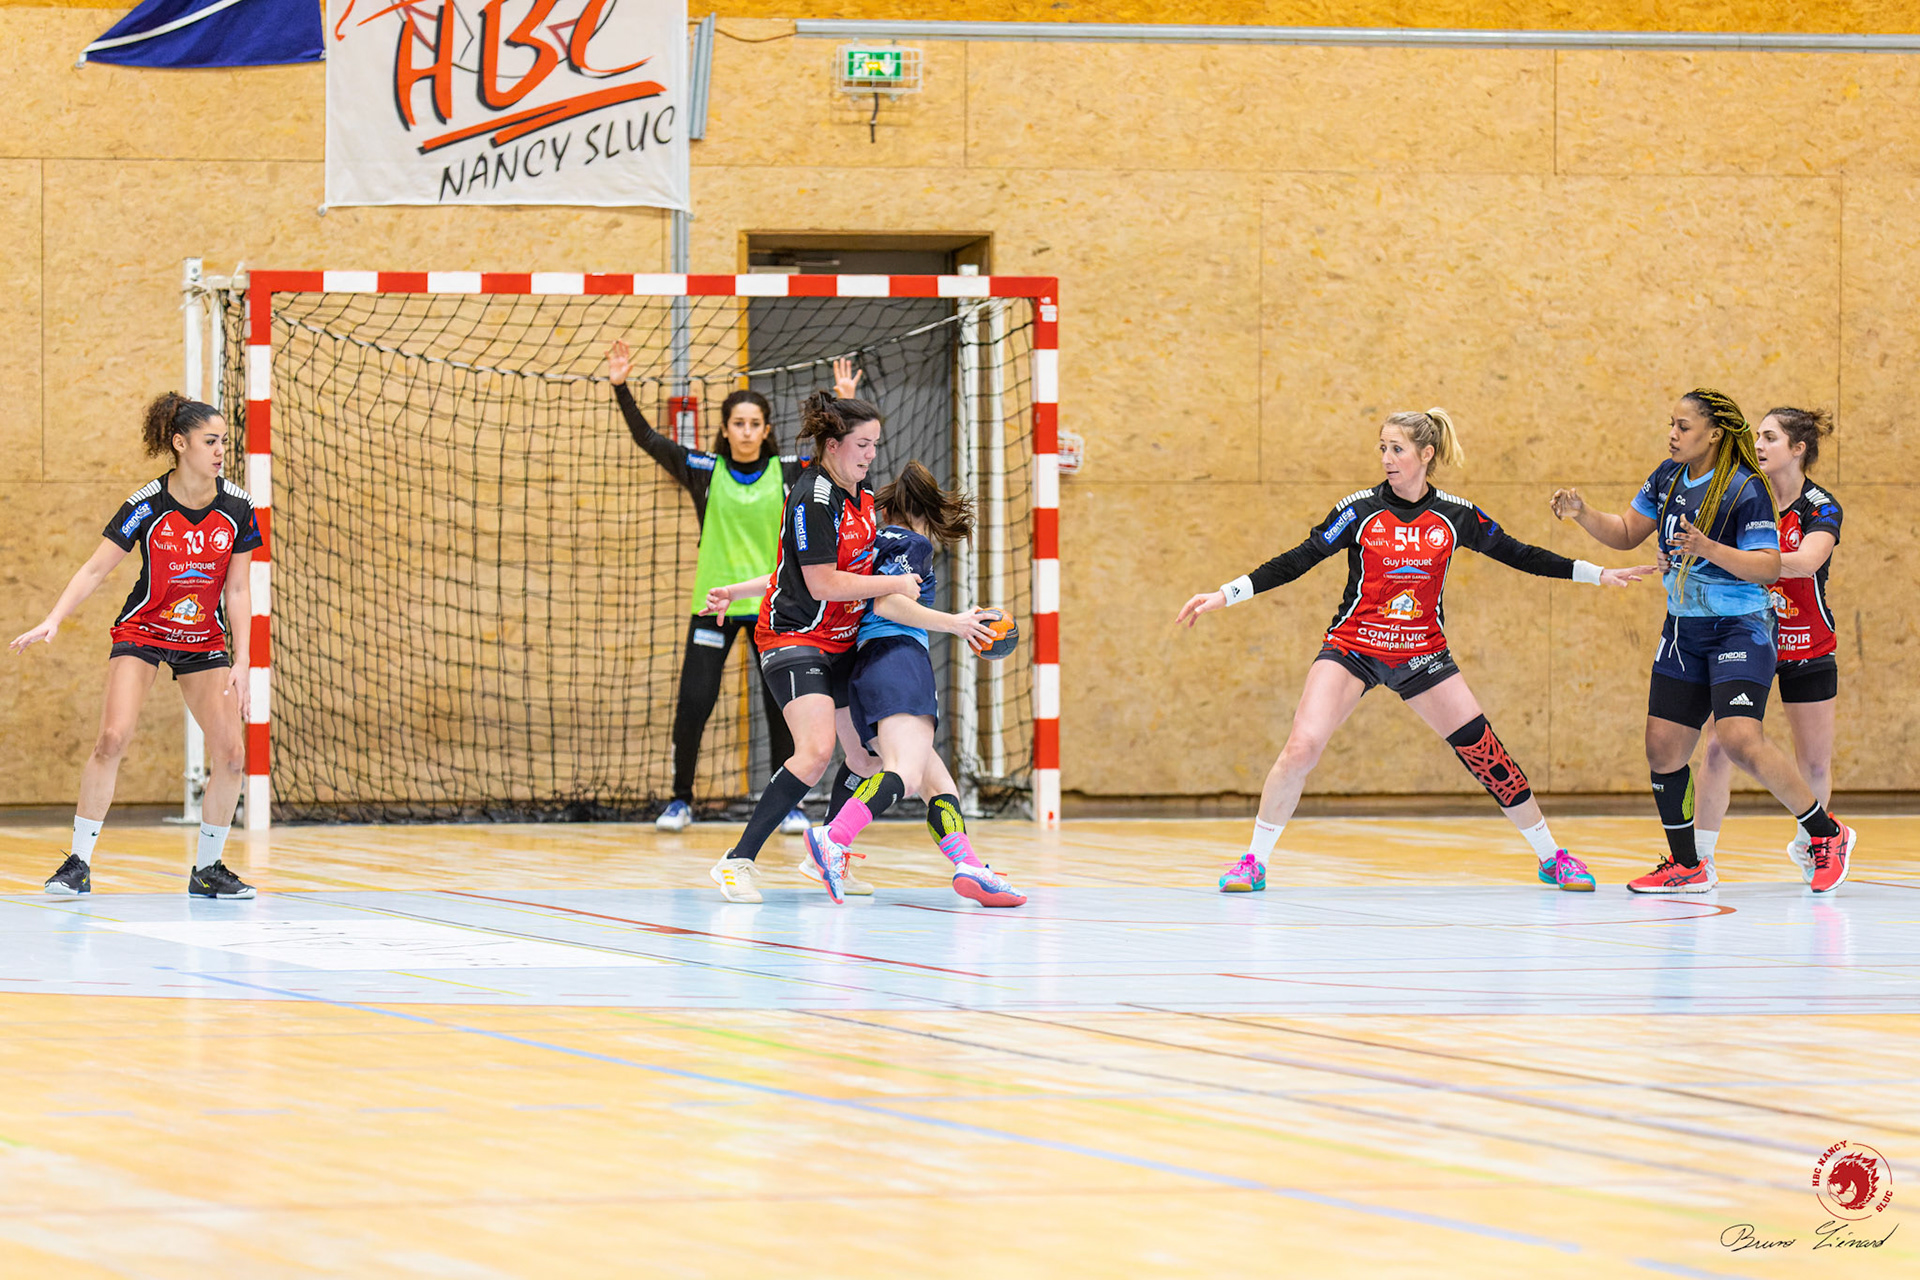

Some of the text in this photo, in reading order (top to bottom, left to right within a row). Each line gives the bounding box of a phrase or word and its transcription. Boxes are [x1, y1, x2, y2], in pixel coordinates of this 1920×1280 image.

[394, 0, 654, 131] HBC
[439, 105, 675, 202] NANCY SLUC
[182, 530, 205, 555] 10
[1394, 526, 1420, 551] 54
[168, 561, 216, 572] Guy Hoquet
[1382, 557, 1433, 567] Guy Hoquet
[1370, 638, 1415, 651] Campanile
